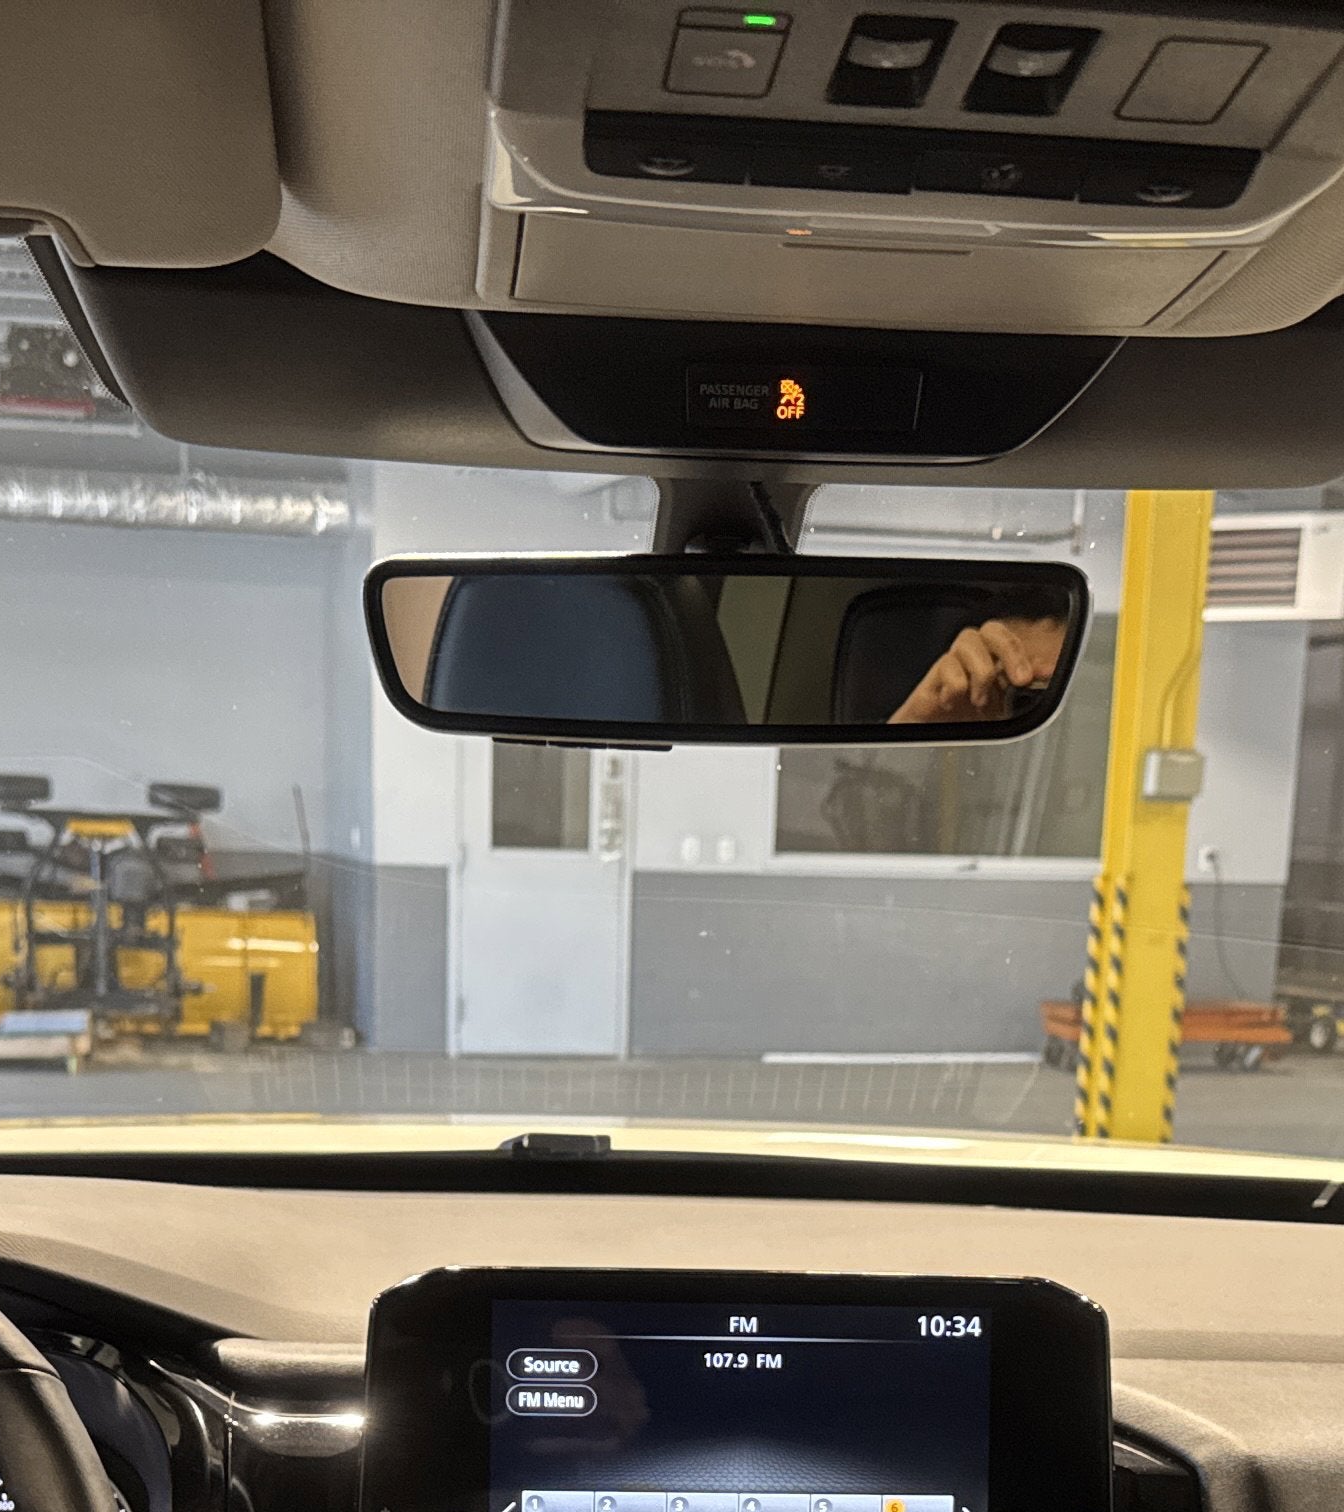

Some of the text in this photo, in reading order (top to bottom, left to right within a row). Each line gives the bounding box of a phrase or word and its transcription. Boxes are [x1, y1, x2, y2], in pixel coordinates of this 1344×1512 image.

[699, 384, 770, 396] PASSENGER
[708, 398, 759, 410] AIR BAG
[776, 405, 805, 419] OFF
[729, 1315, 982, 1337] FM 10:34
[524, 1357, 579, 1373] Source
[704, 1353, 782, 1369] 107.9 FM
[518, 1392, 584, 1409] FM Menu
[531, 1499, 539, 1510] 1
[602, 1500, 612, 1511] 2
[674, 1500, 684, 1512] 3
[745, 1501, 756, 1512] 4
[818, 1502, 828, 1512] 5
[891, 1503, 899, 1512] 6
